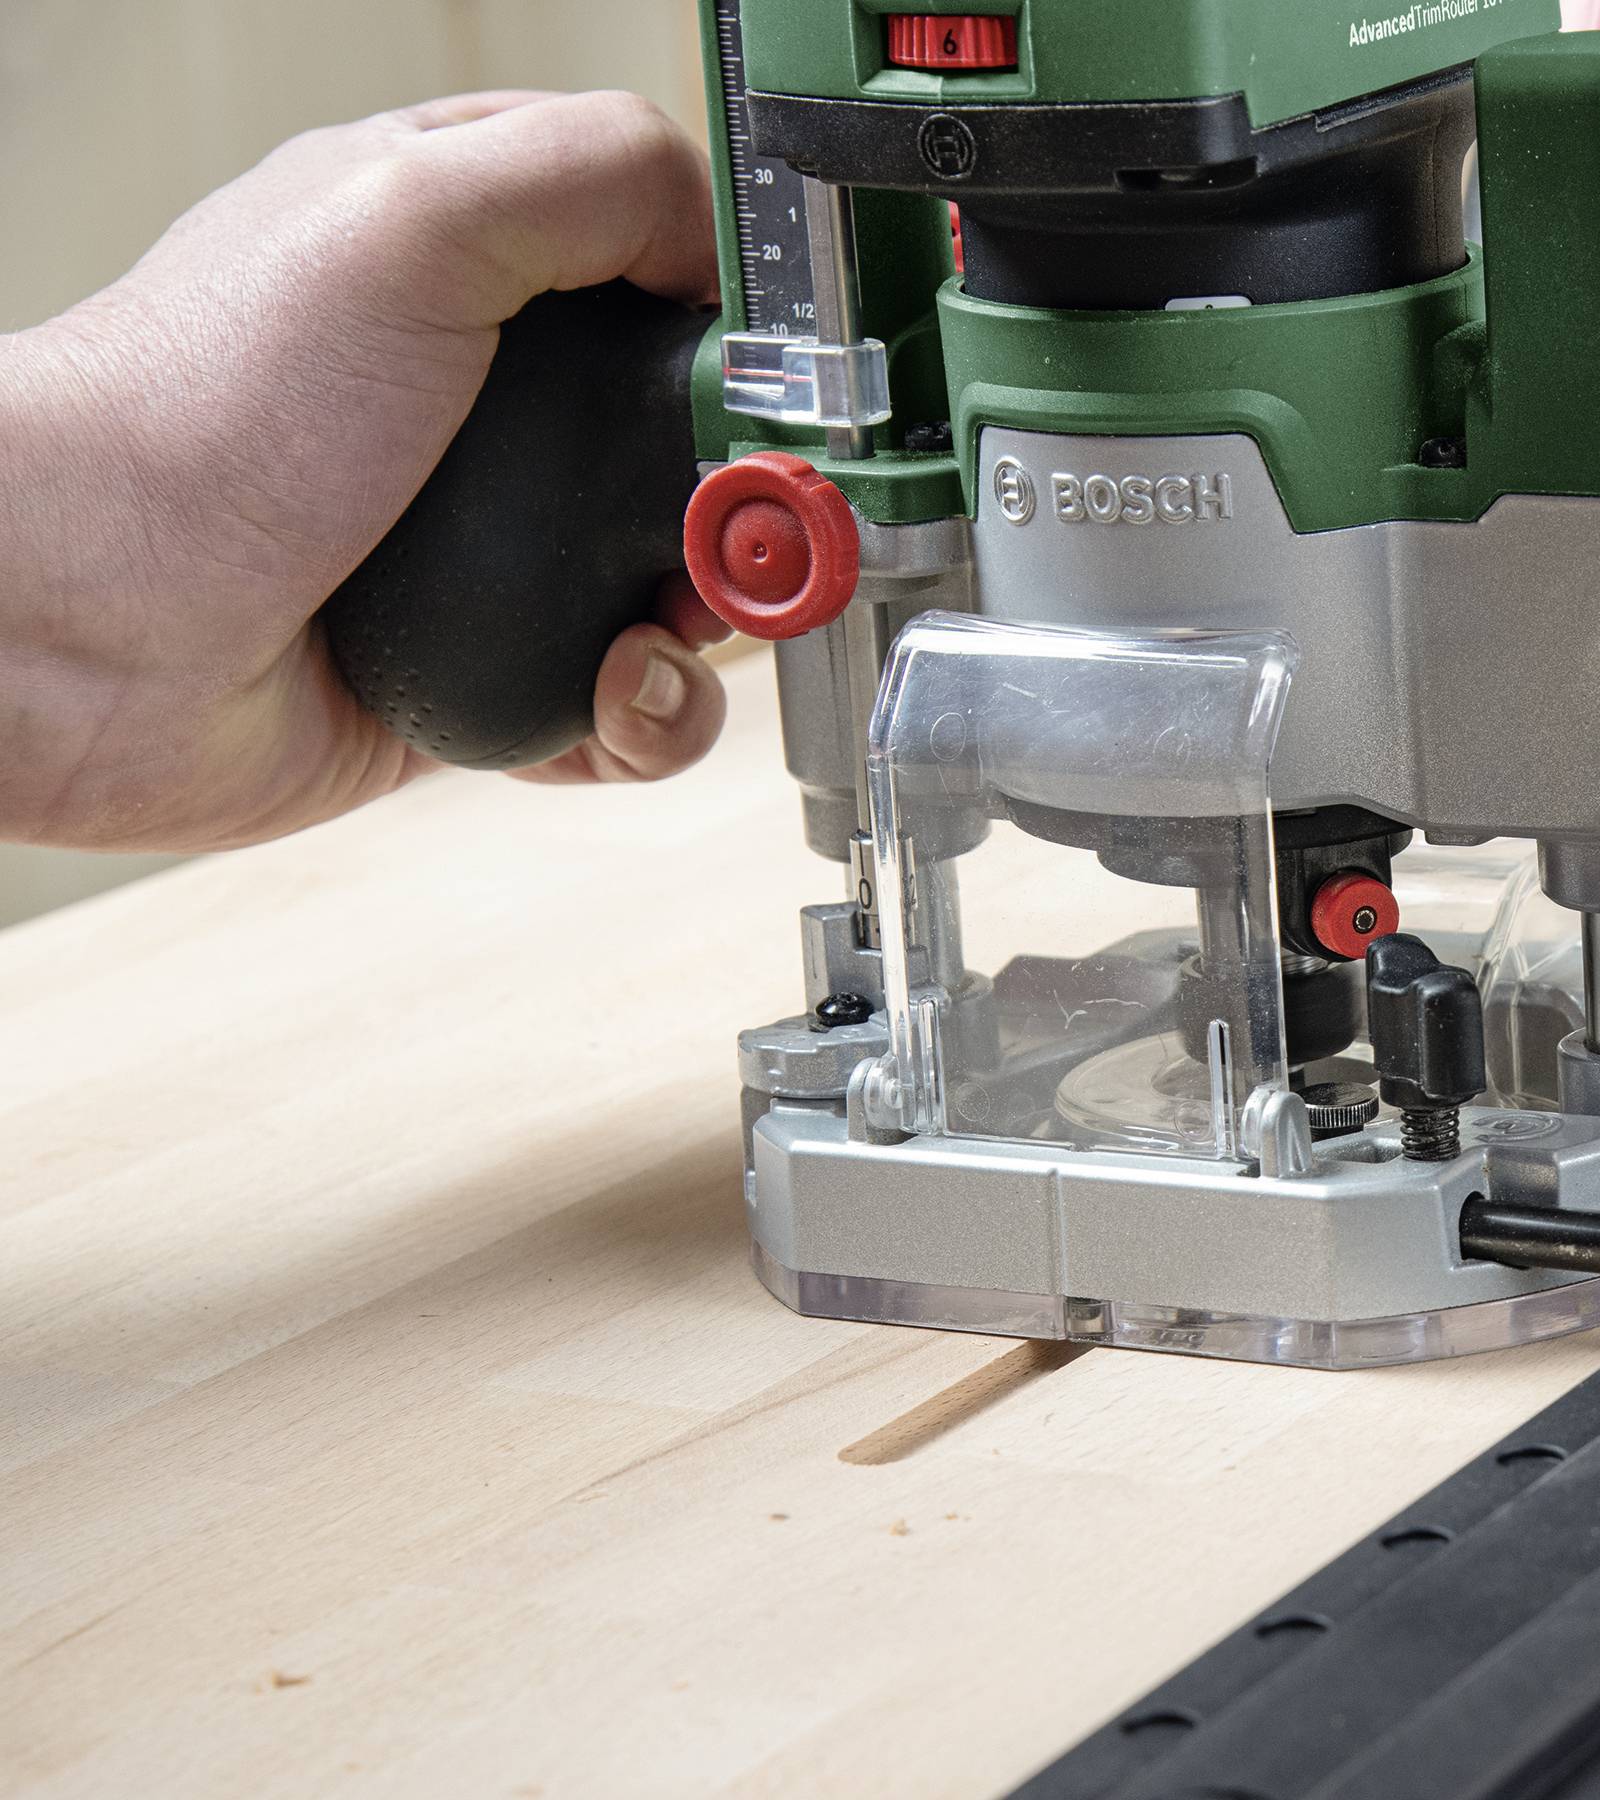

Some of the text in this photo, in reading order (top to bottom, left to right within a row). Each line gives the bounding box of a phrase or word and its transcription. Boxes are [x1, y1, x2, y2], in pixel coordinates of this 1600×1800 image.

[1349, 0, 1478, 47] AdvancedTrimRouter
[943, 29, 957, 55] 6
[754, 168, 773, 184] 30
[788, 206, 796, 223] 1
[763, 244, 781, 261] 20
[792, 302, 815, 319] 1/2
[770, 323, 788, 337] 10
[1050, 471, 1233, 525] BOSCH
